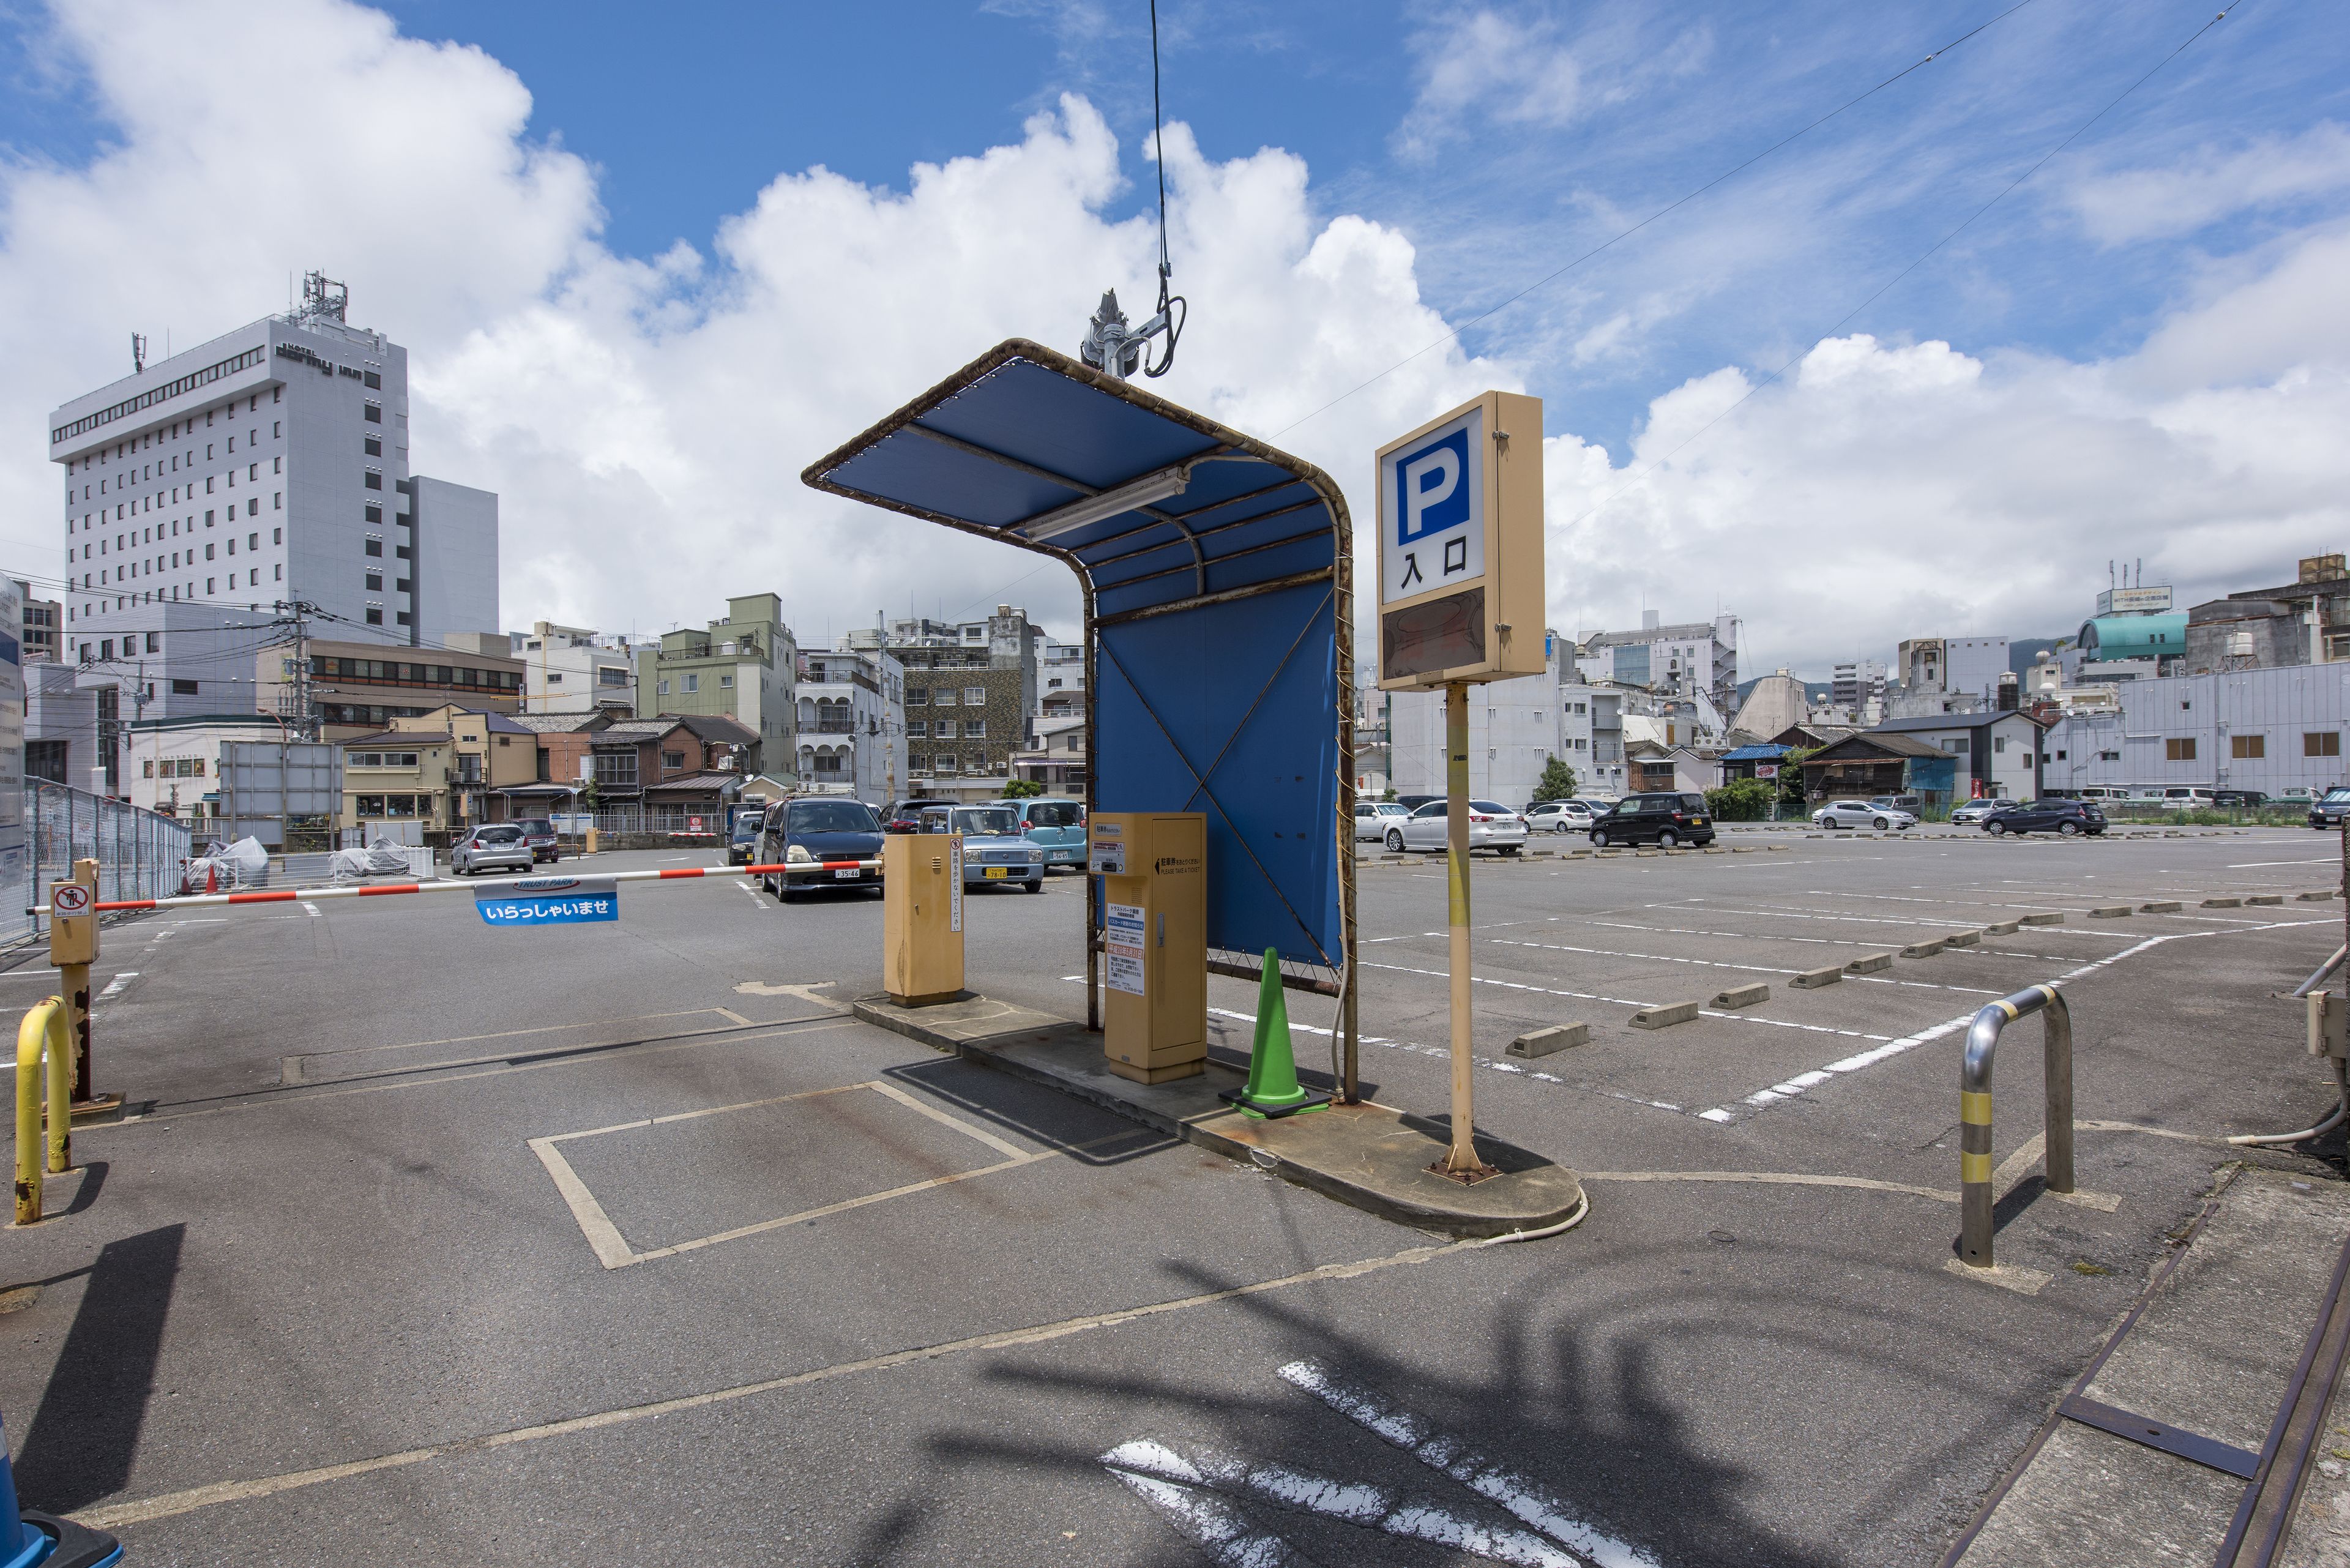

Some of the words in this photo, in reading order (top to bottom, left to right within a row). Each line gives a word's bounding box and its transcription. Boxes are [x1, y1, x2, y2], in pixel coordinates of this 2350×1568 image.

[275, 343, 332, 376] dormy
[338, 364, 362, 381] inn
[288, 343, 317, 356] HOTEL
[1406, 447, 1460, 536] P
[1401, 536, 1466, 589] 入口
[518, 879, 549, 888] TRUST
[487, 900, 608, 919] いらっしゃいませ
